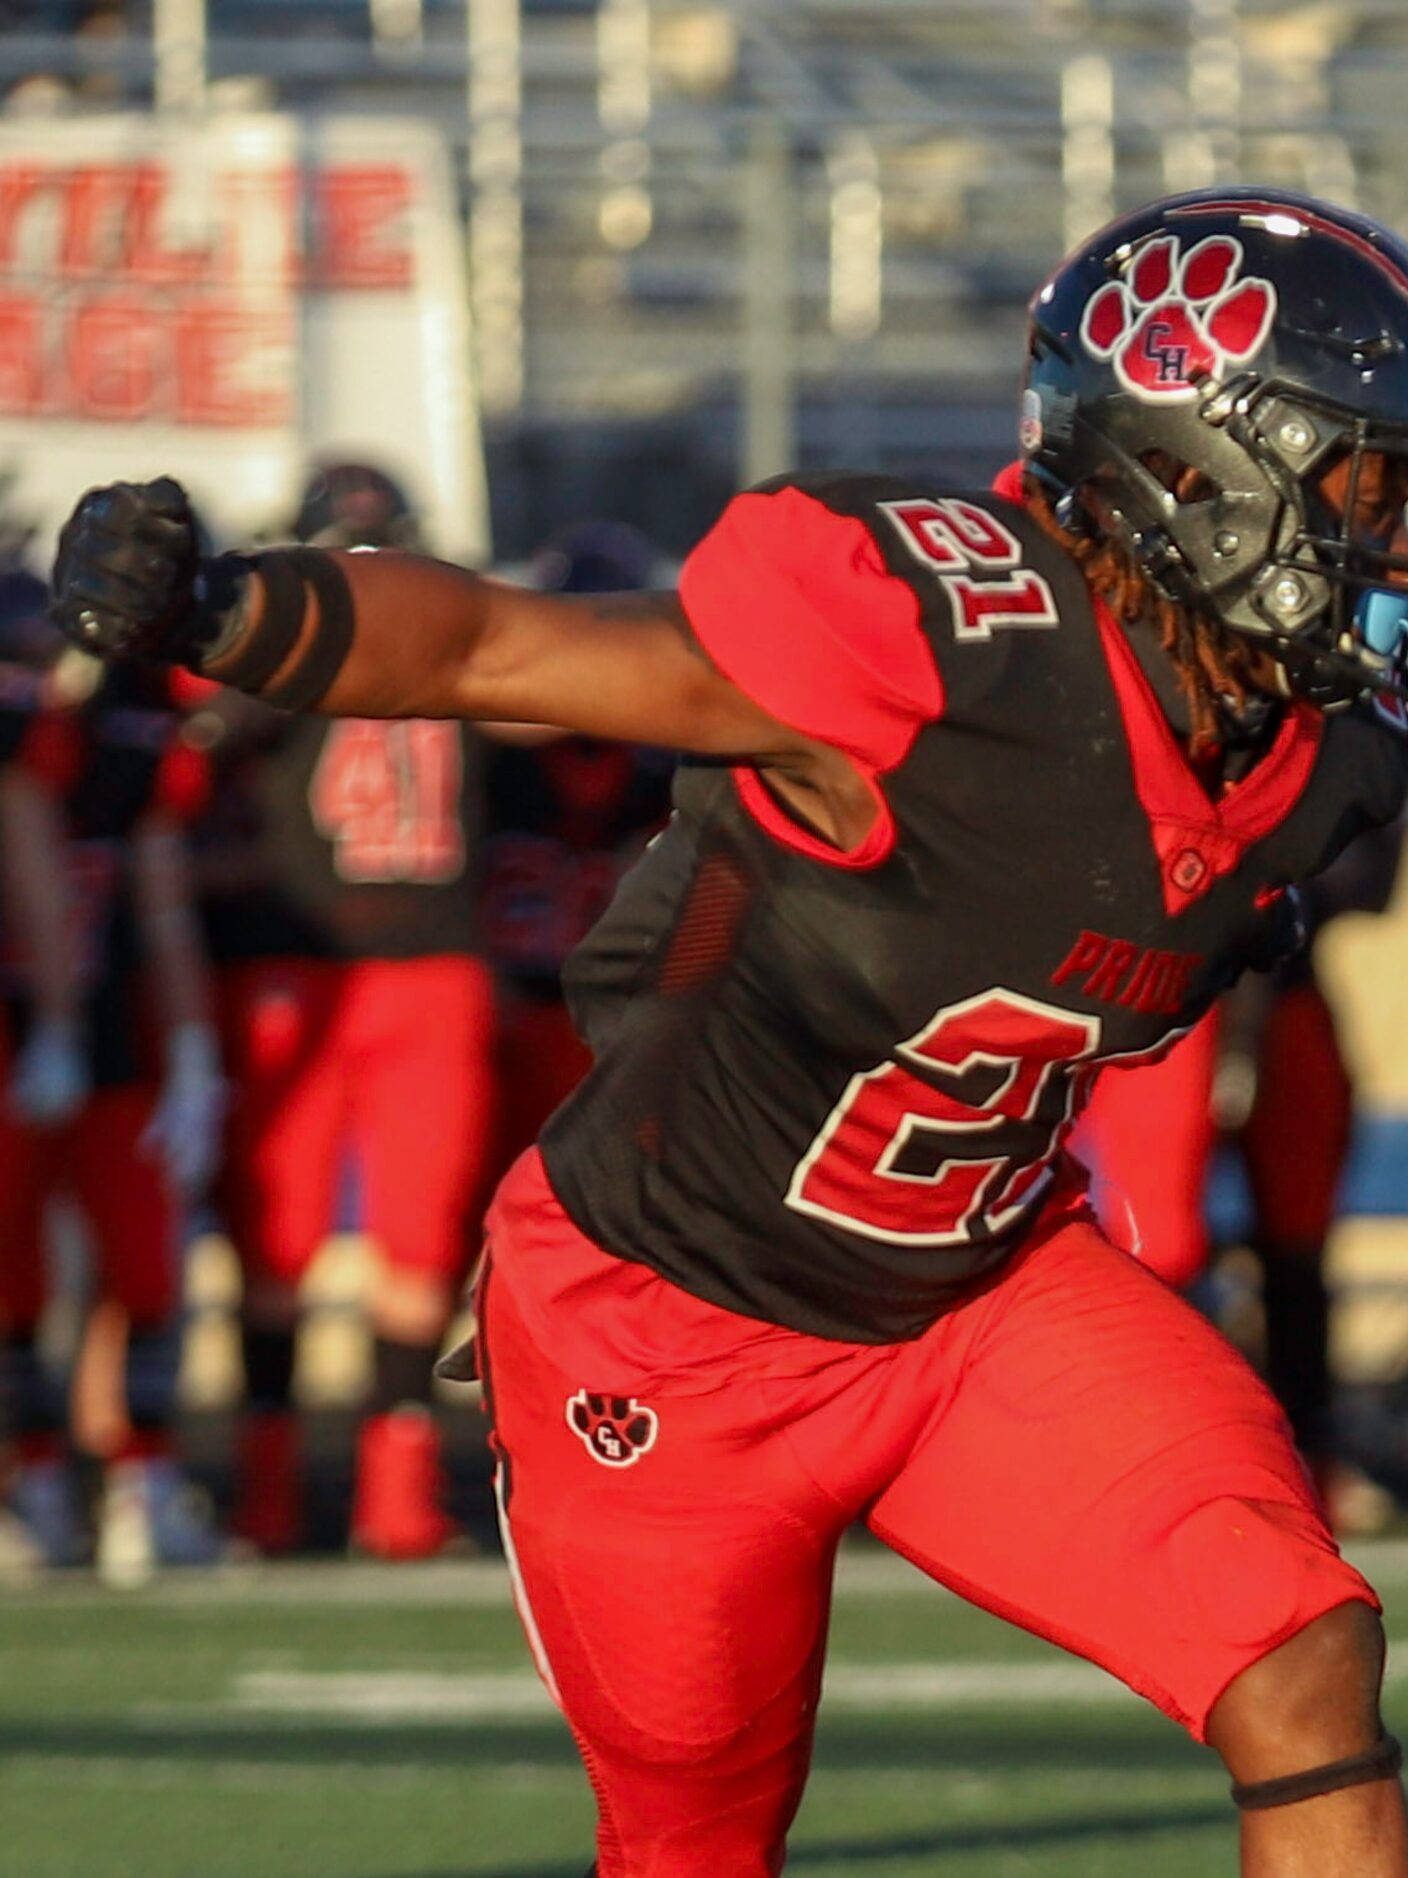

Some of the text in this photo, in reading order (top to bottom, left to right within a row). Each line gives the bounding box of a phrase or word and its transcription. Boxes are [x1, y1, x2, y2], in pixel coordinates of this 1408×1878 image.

[1144, 322, 1189, 382] CH
[876, 498, 1060, 641] 21
[307, 718, 467, 884] 41
